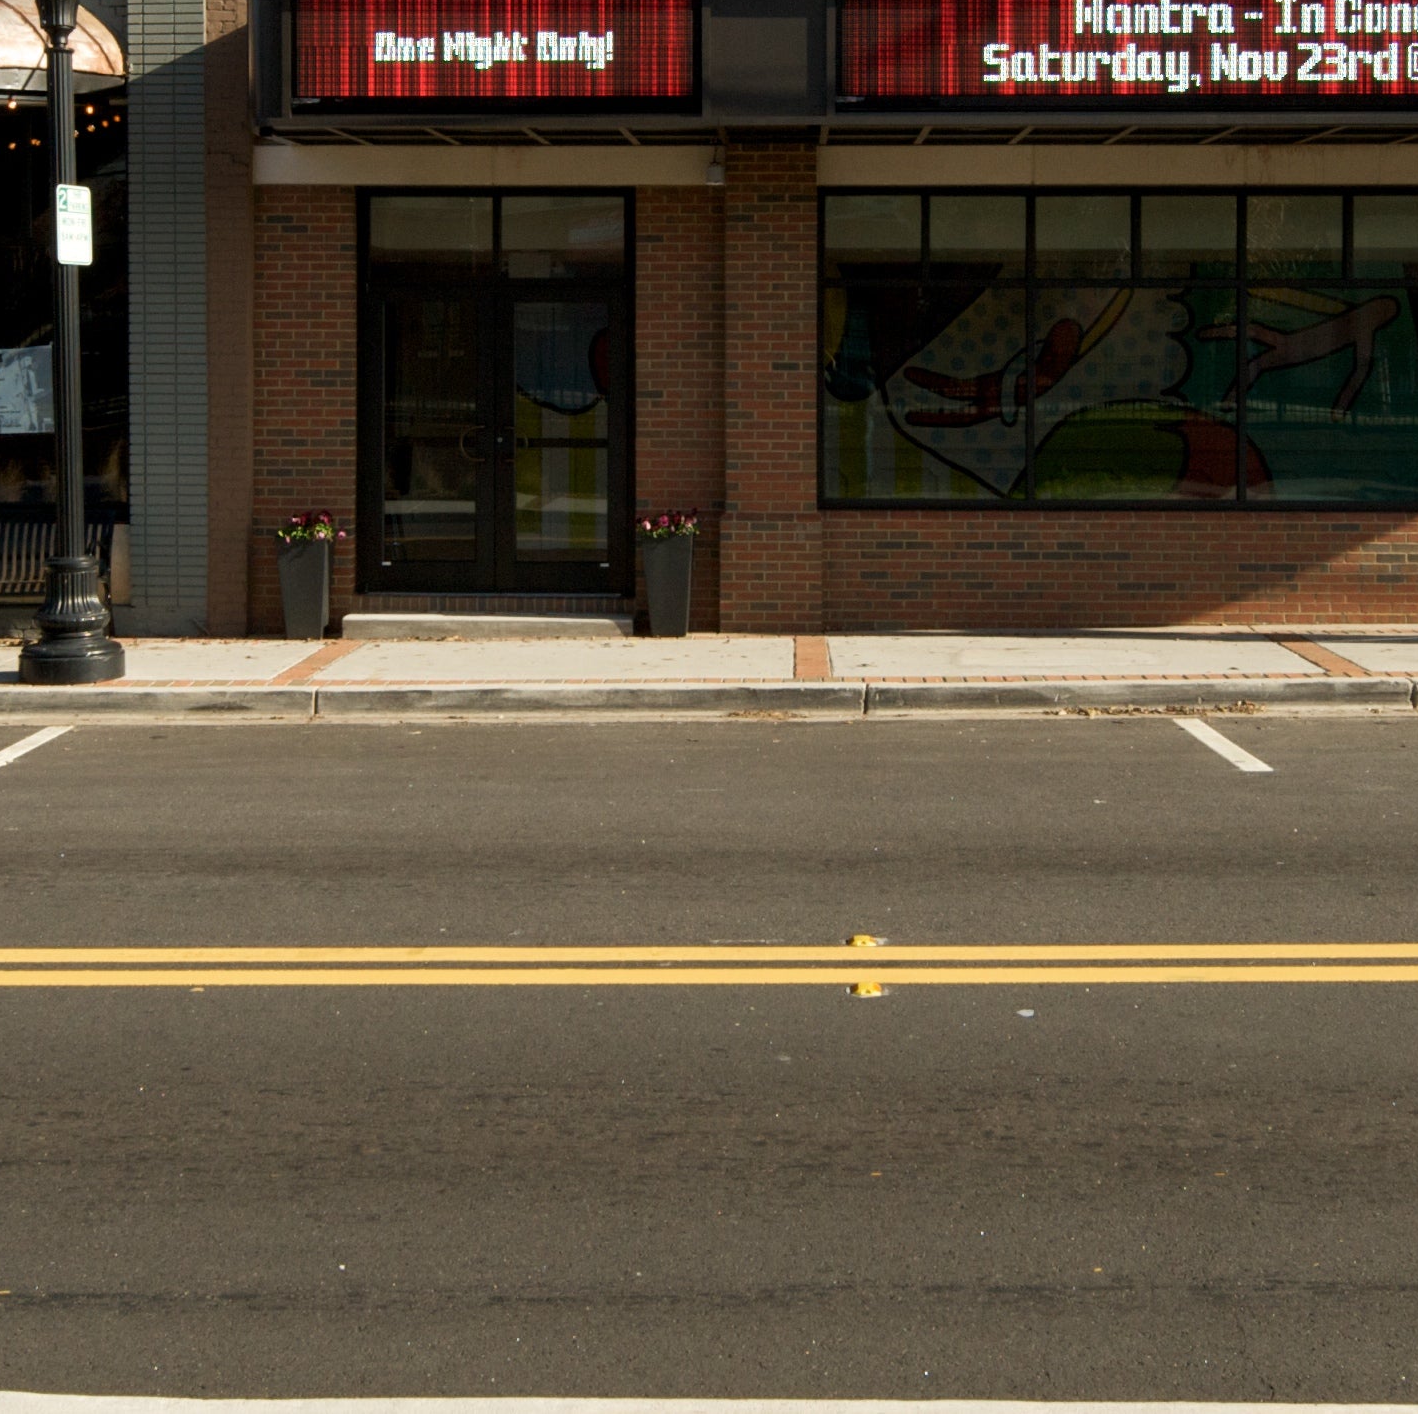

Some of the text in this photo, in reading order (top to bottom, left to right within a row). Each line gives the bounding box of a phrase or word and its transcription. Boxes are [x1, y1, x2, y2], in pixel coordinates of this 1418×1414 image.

[374, 31, 614, 70] One Night Only!
[982, 42, 1202, 93] Saturday,
[1211, 42, 1288, 82] Nov
[1297, 42, 1399, 82] 23rd
[58, 189, 68, 209] 2
